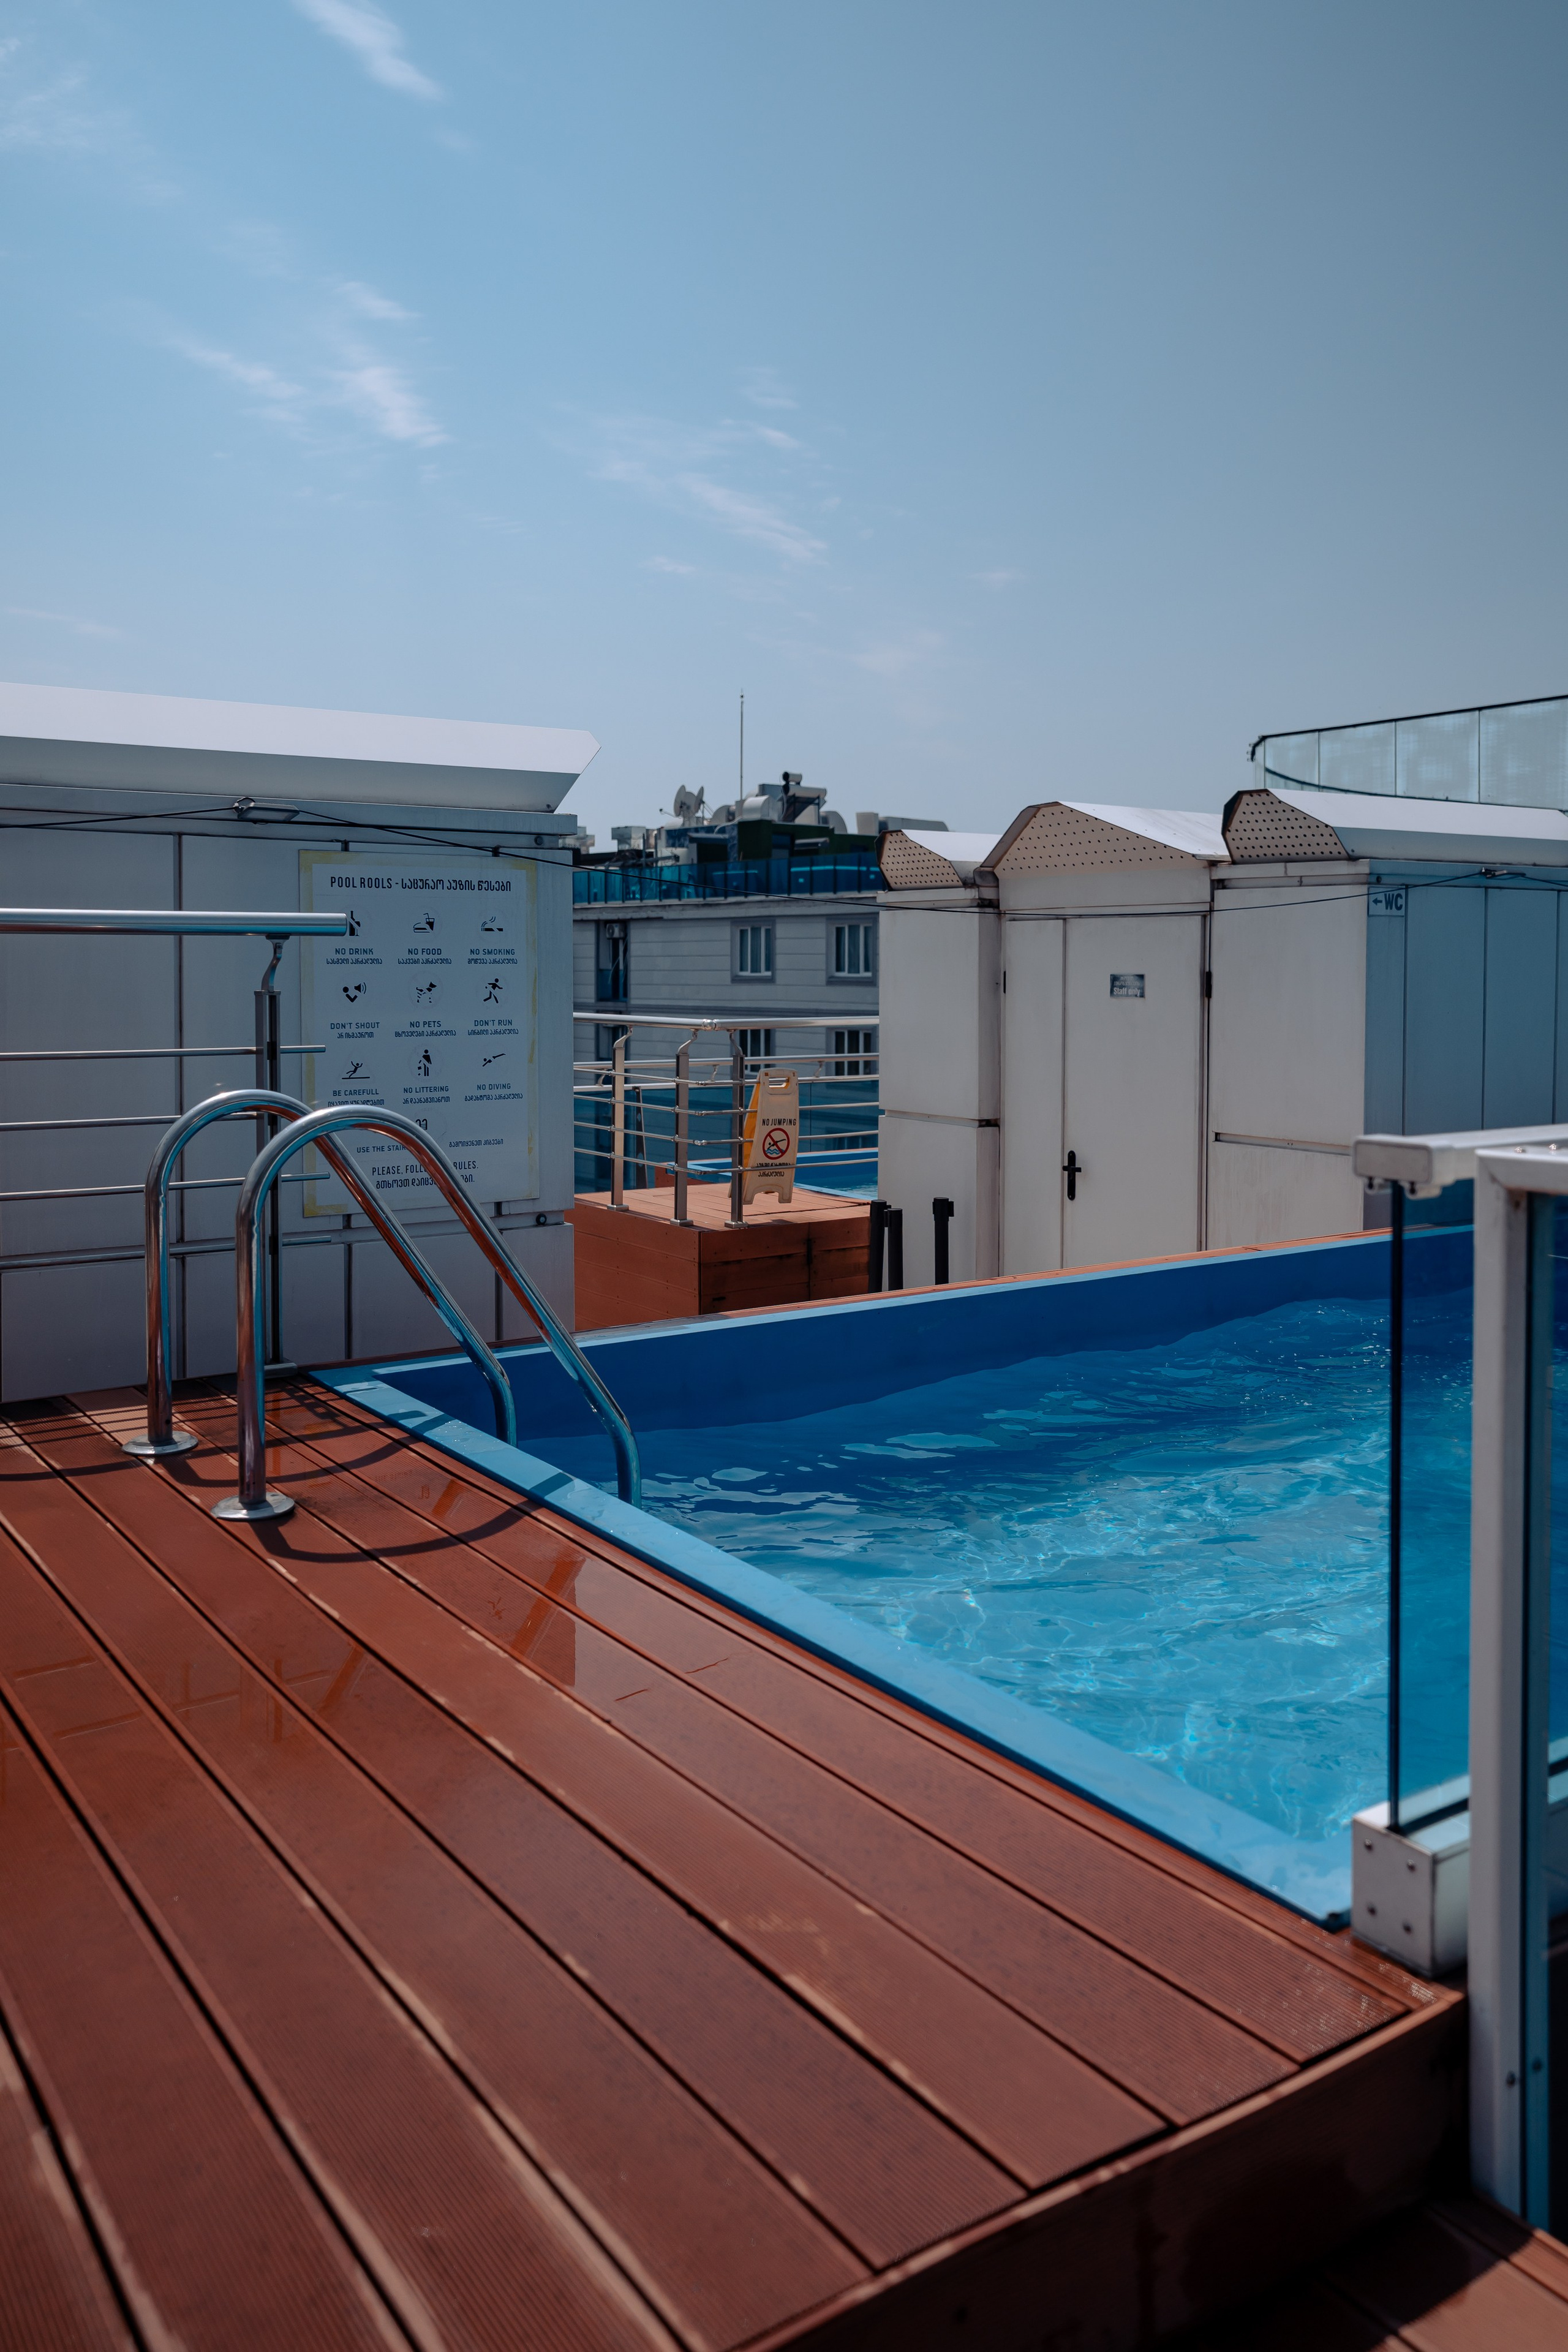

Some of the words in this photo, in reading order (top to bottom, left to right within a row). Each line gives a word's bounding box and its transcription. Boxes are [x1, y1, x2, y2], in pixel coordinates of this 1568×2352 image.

[330, 876, 357, 888] POOL
[360, 878, 392, 889] ROOLS
[401, 878, 444, 890] საცურაო
[447, 880, 475, 891] აუზის
[478, 880, 511, 892] წესები
[1384, 893, 1403, 911] WC
[1128, 988, 1140, 997] only
[372, 1166, 403, 1175] PLEASE,
[405, 1164, 428, 1174] FOLL
[376, 1178, 409, 1189] გთხოვთ
